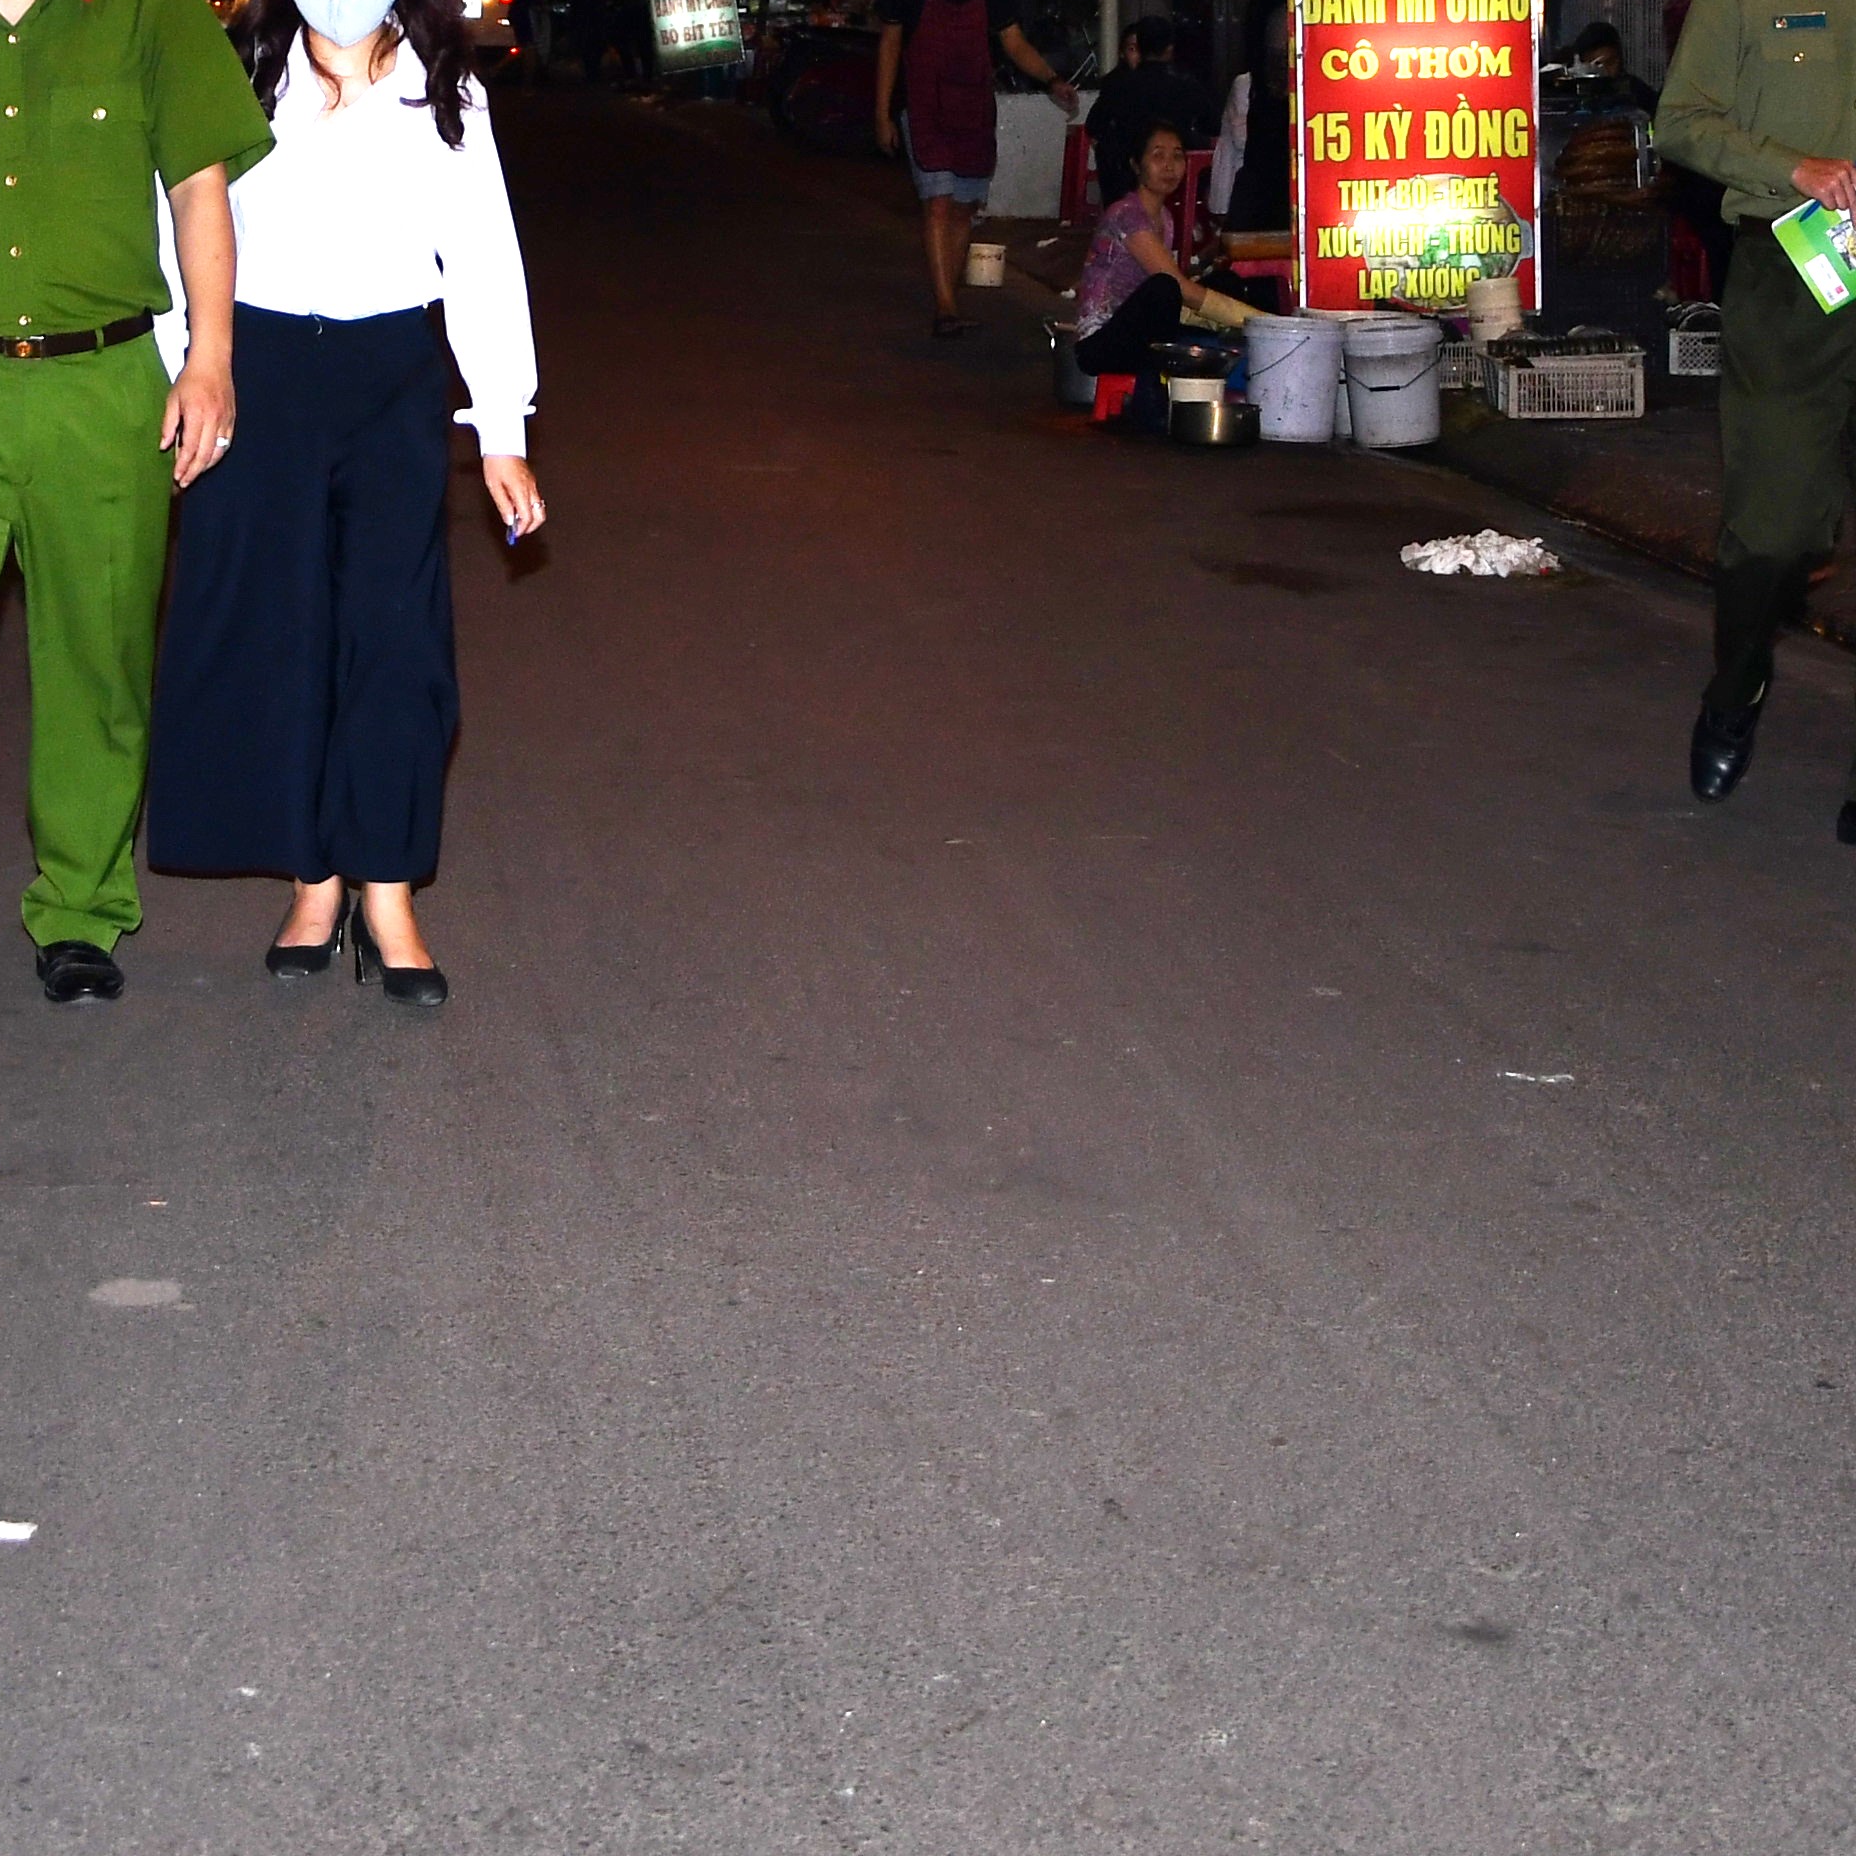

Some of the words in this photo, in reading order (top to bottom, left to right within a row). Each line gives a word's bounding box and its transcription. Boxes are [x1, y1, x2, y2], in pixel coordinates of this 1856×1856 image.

[1320, 38, 1379, 81] CÔ
[1389, 39, 1513, 81] THƠM
[1306, 110, 1352, 163] 15
[1363, 103, 1413, 162] KỲ
[1423, 93, 1530, 160] ĐỒNG
[1395, 173, 1429, 211] BÒ
[1448, 172, 1500, 210] PATÊ
[1317, 221, 1364, 259] XÚC
[1446, 218, 1522, 255] TRỨNG
